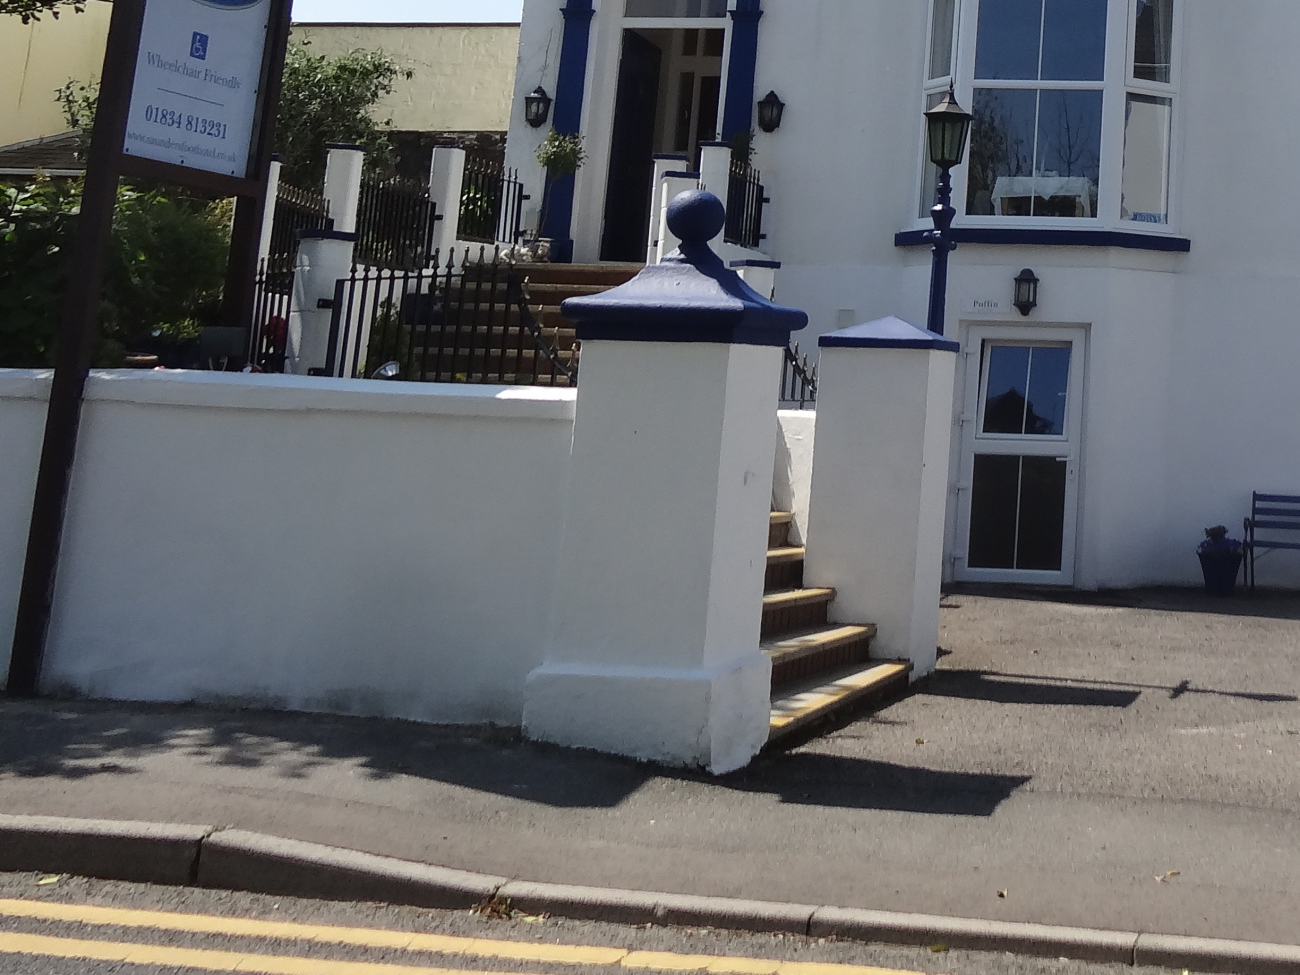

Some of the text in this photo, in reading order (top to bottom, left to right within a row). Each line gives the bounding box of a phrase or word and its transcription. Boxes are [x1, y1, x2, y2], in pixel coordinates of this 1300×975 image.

[147, 51, 242, 91] Wheelchair Friendly
[145, 104, 227, 140] 01834 813231
[973, 299, 999, 309] Puffin
